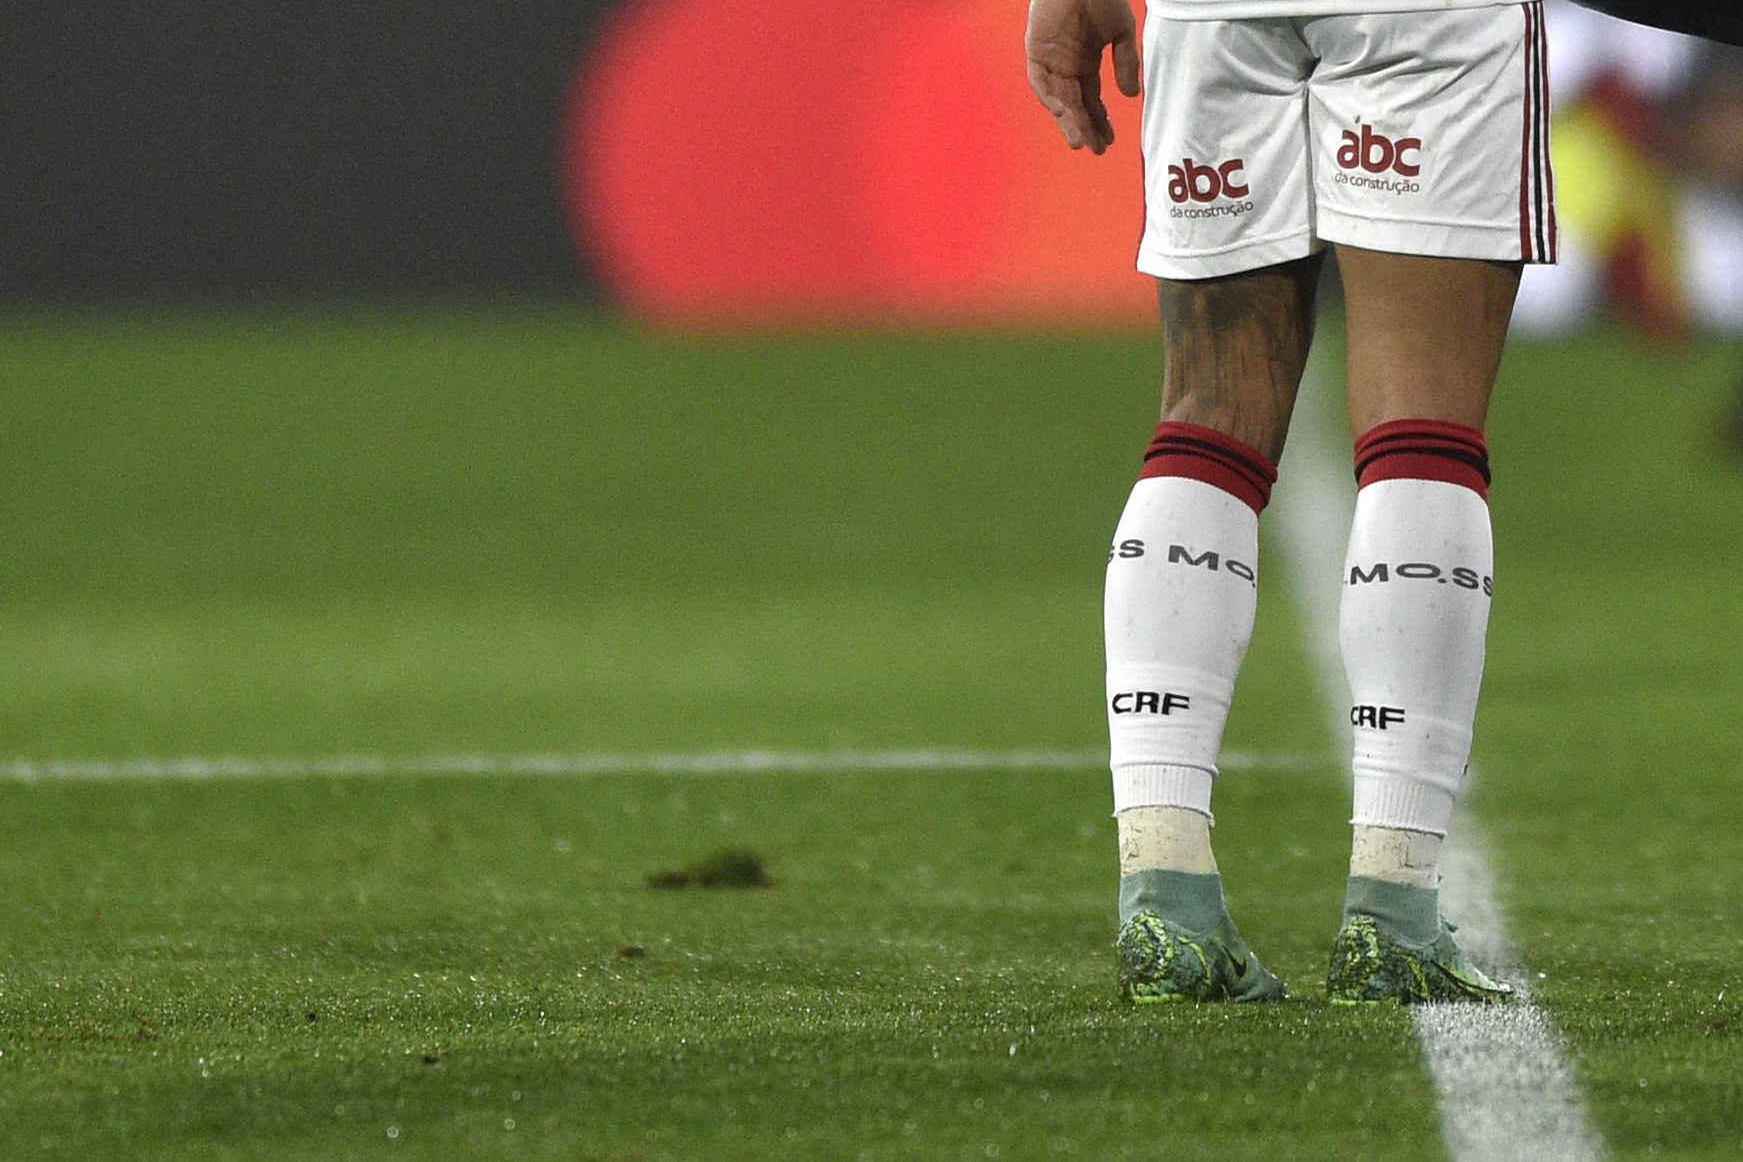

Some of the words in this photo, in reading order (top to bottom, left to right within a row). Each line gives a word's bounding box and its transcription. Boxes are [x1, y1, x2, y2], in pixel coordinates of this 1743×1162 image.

[1336, 124, 1422, 177] abc
[1167, 157, 1250, 204] abc
[1350, 176, 1420, 195] construção
[1184, 201, 1254, 218] construção
[1111, 691, 1191, 716] CRF
[1350, 705, 1405, 730] CRF
